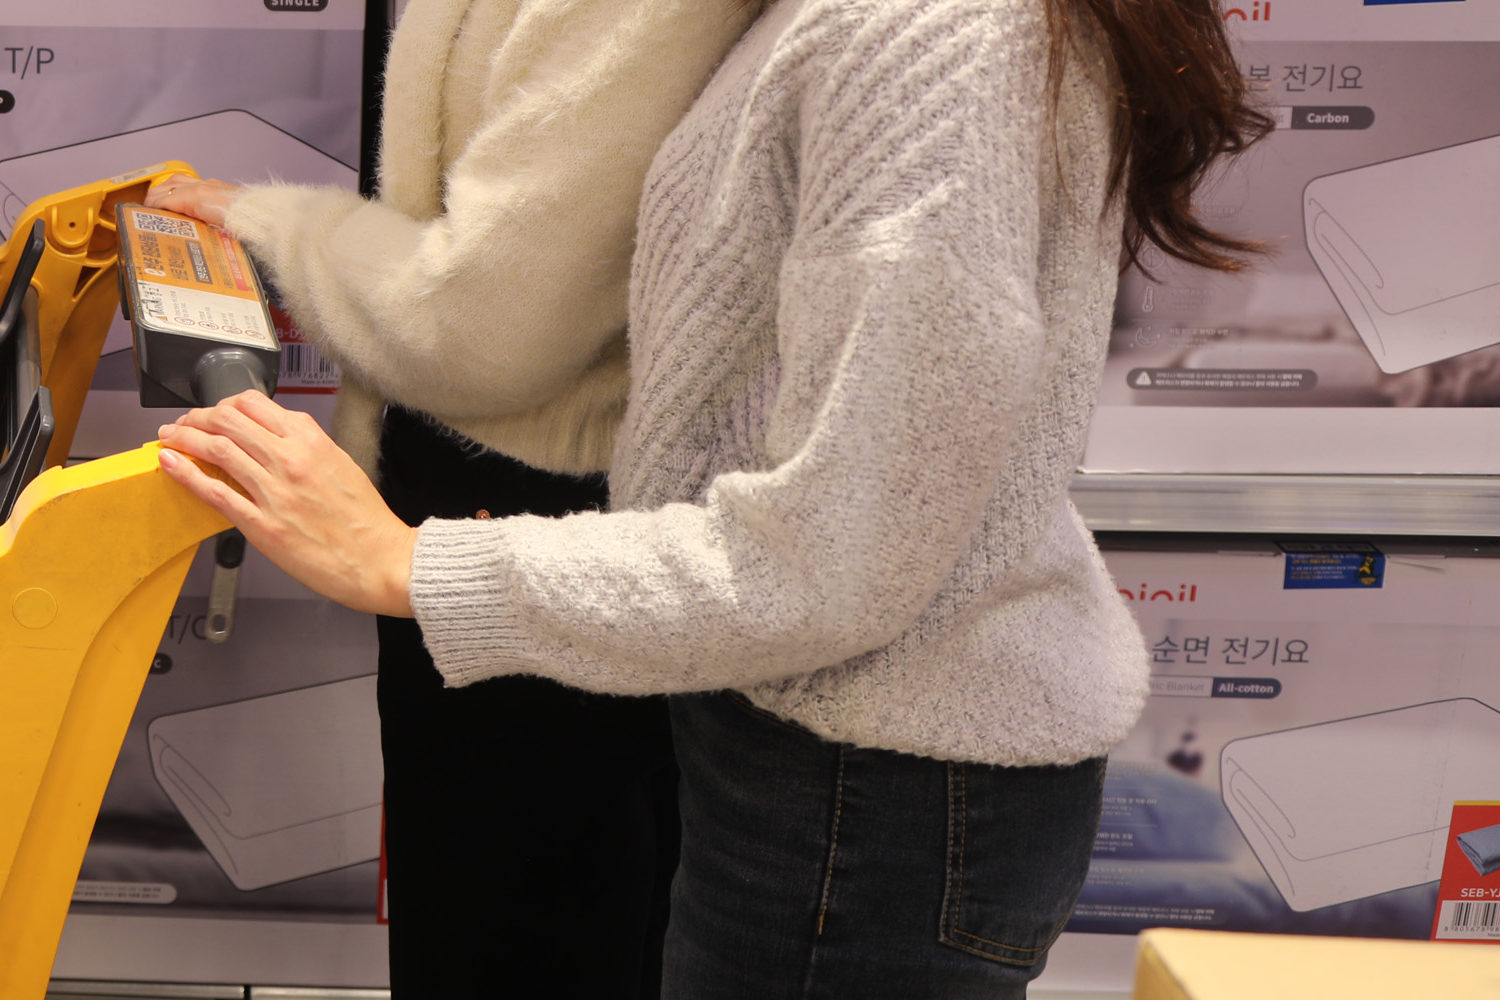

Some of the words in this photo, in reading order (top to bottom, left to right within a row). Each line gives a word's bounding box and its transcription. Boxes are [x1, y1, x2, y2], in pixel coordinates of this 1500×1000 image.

[4, 46, 56, 81] T/P
[1282, 64, 1363, 92] 전기요
[1306, 112, 1350, 124] Carbon
[1151, 635, 1210, 664] 순면
[1221, 637, 1310, 666] 전기요
[1219, 682, 1274, 695] All-cotton
